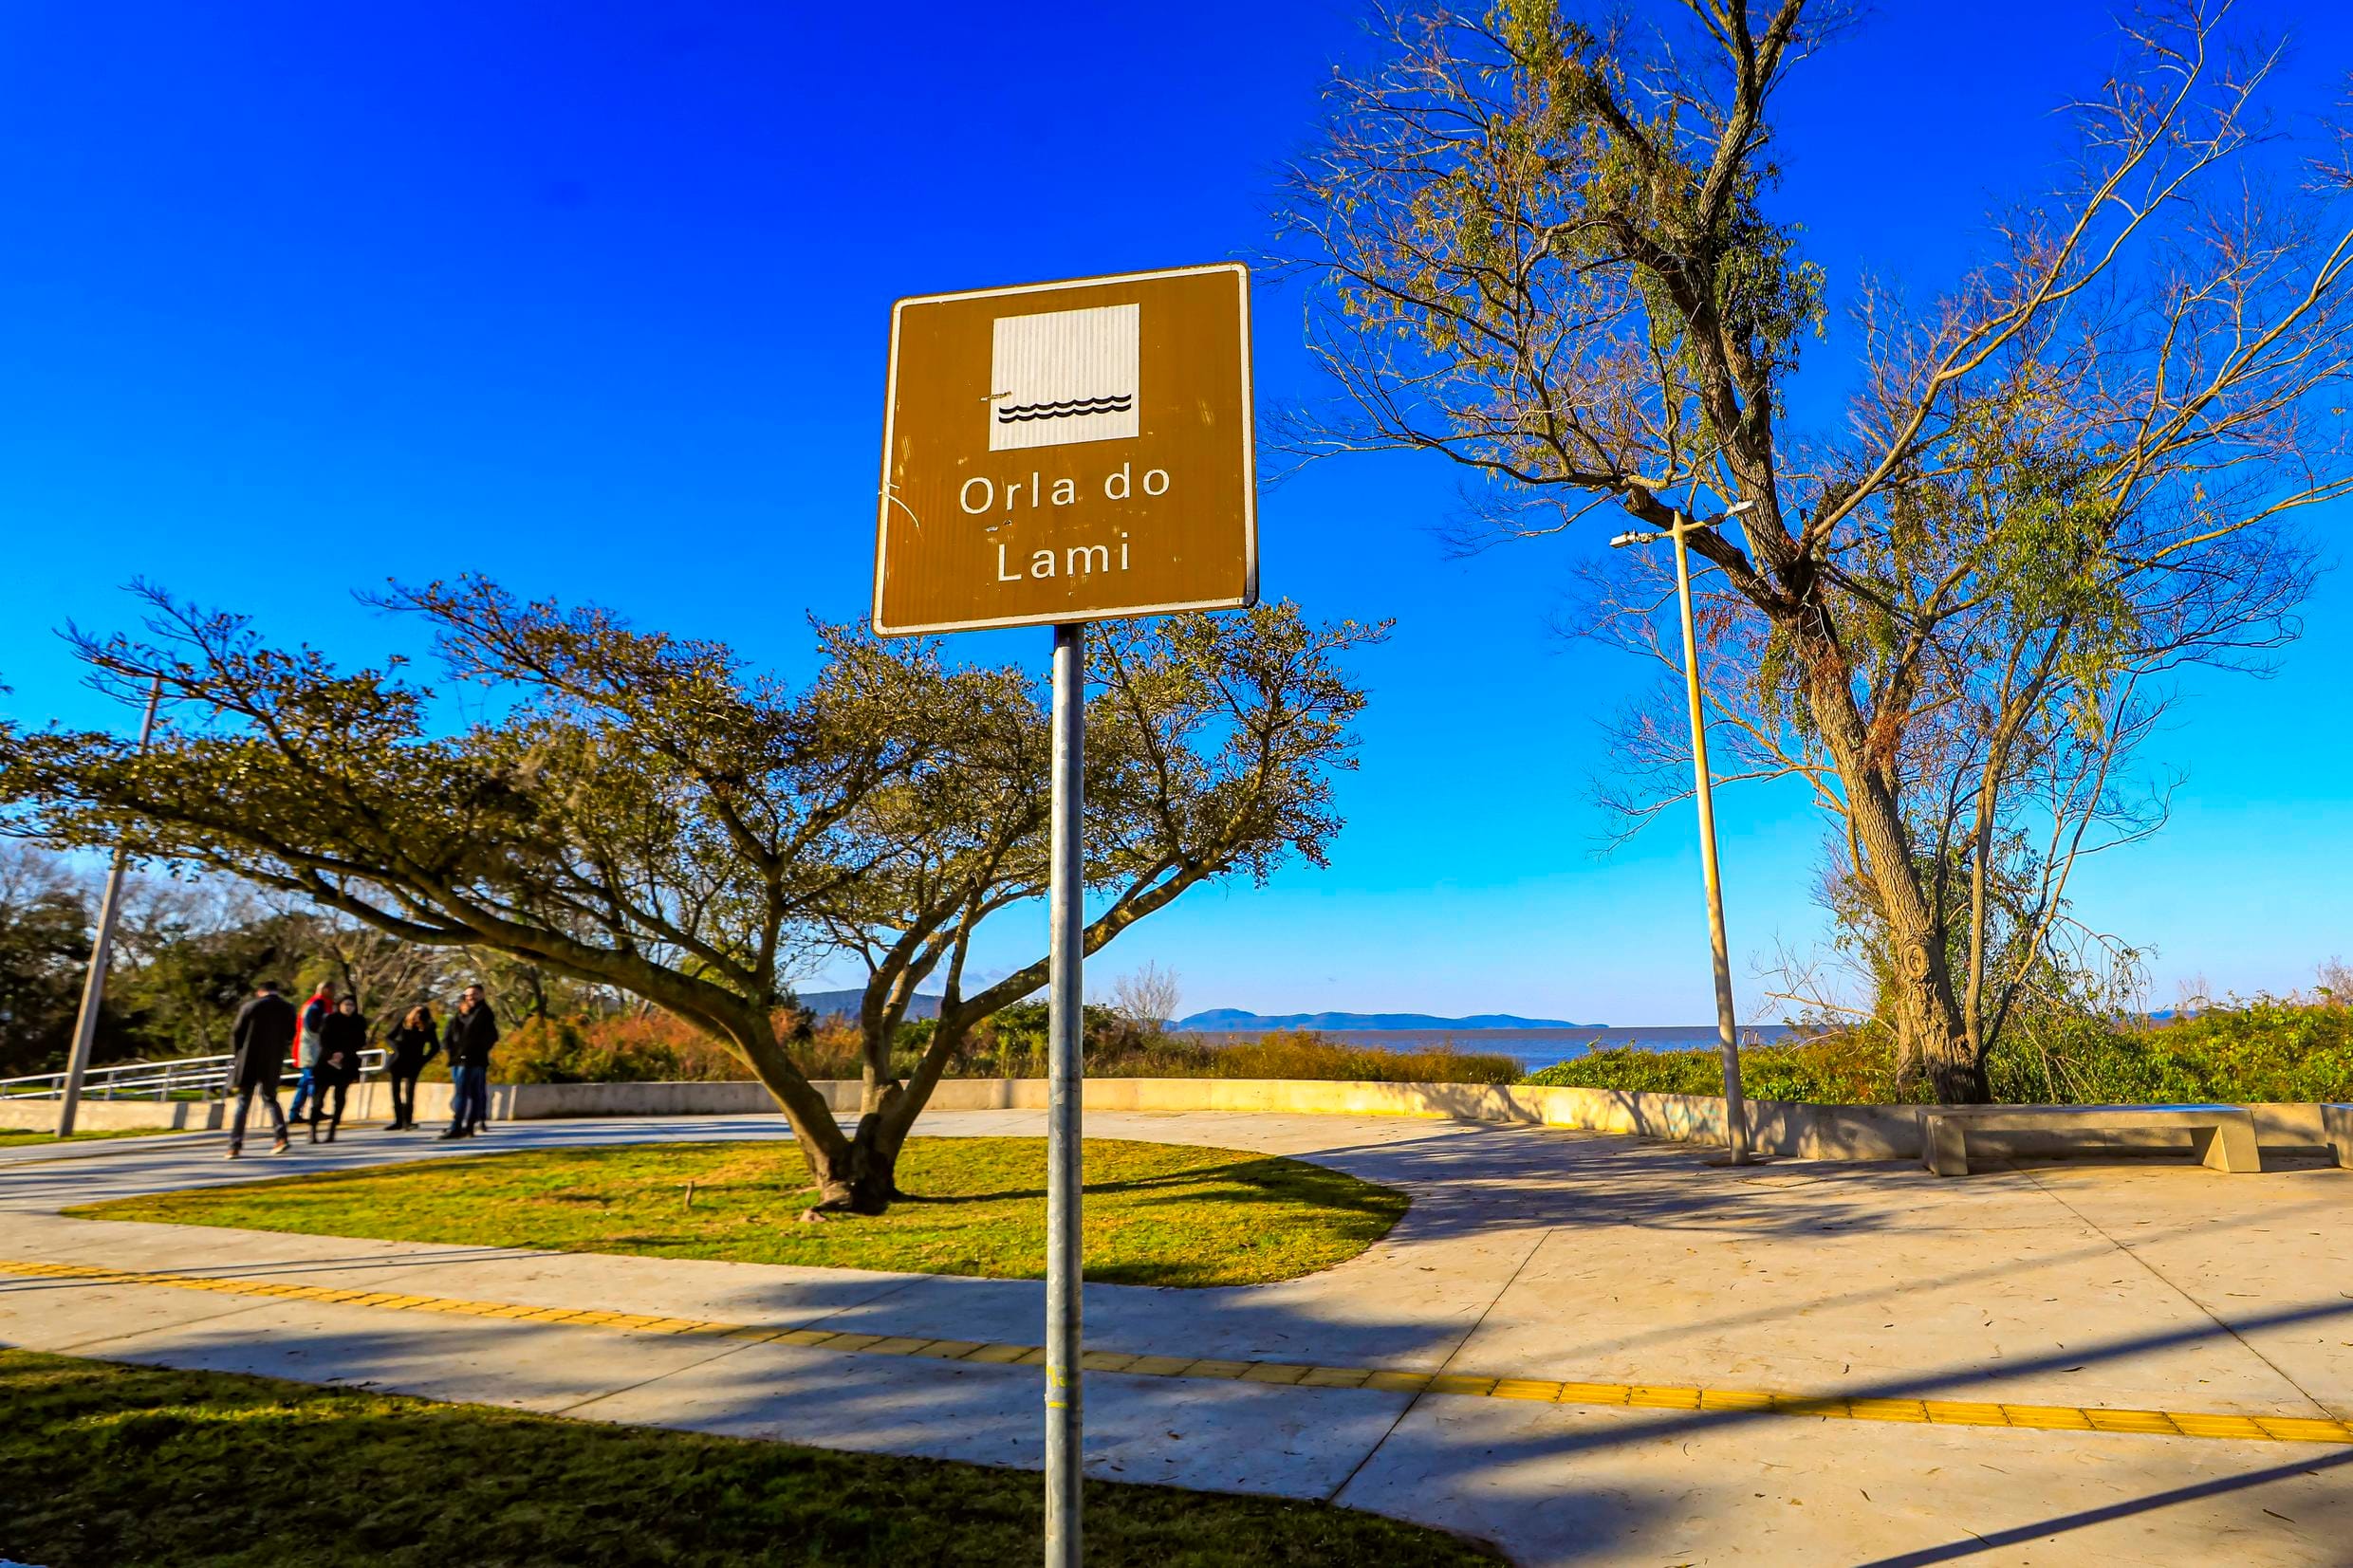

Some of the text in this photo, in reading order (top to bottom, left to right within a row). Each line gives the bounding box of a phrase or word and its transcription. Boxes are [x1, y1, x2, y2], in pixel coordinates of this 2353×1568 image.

[959, 462, 1170, 514] Orla do
[997, 531, 1130, 582] Lami
